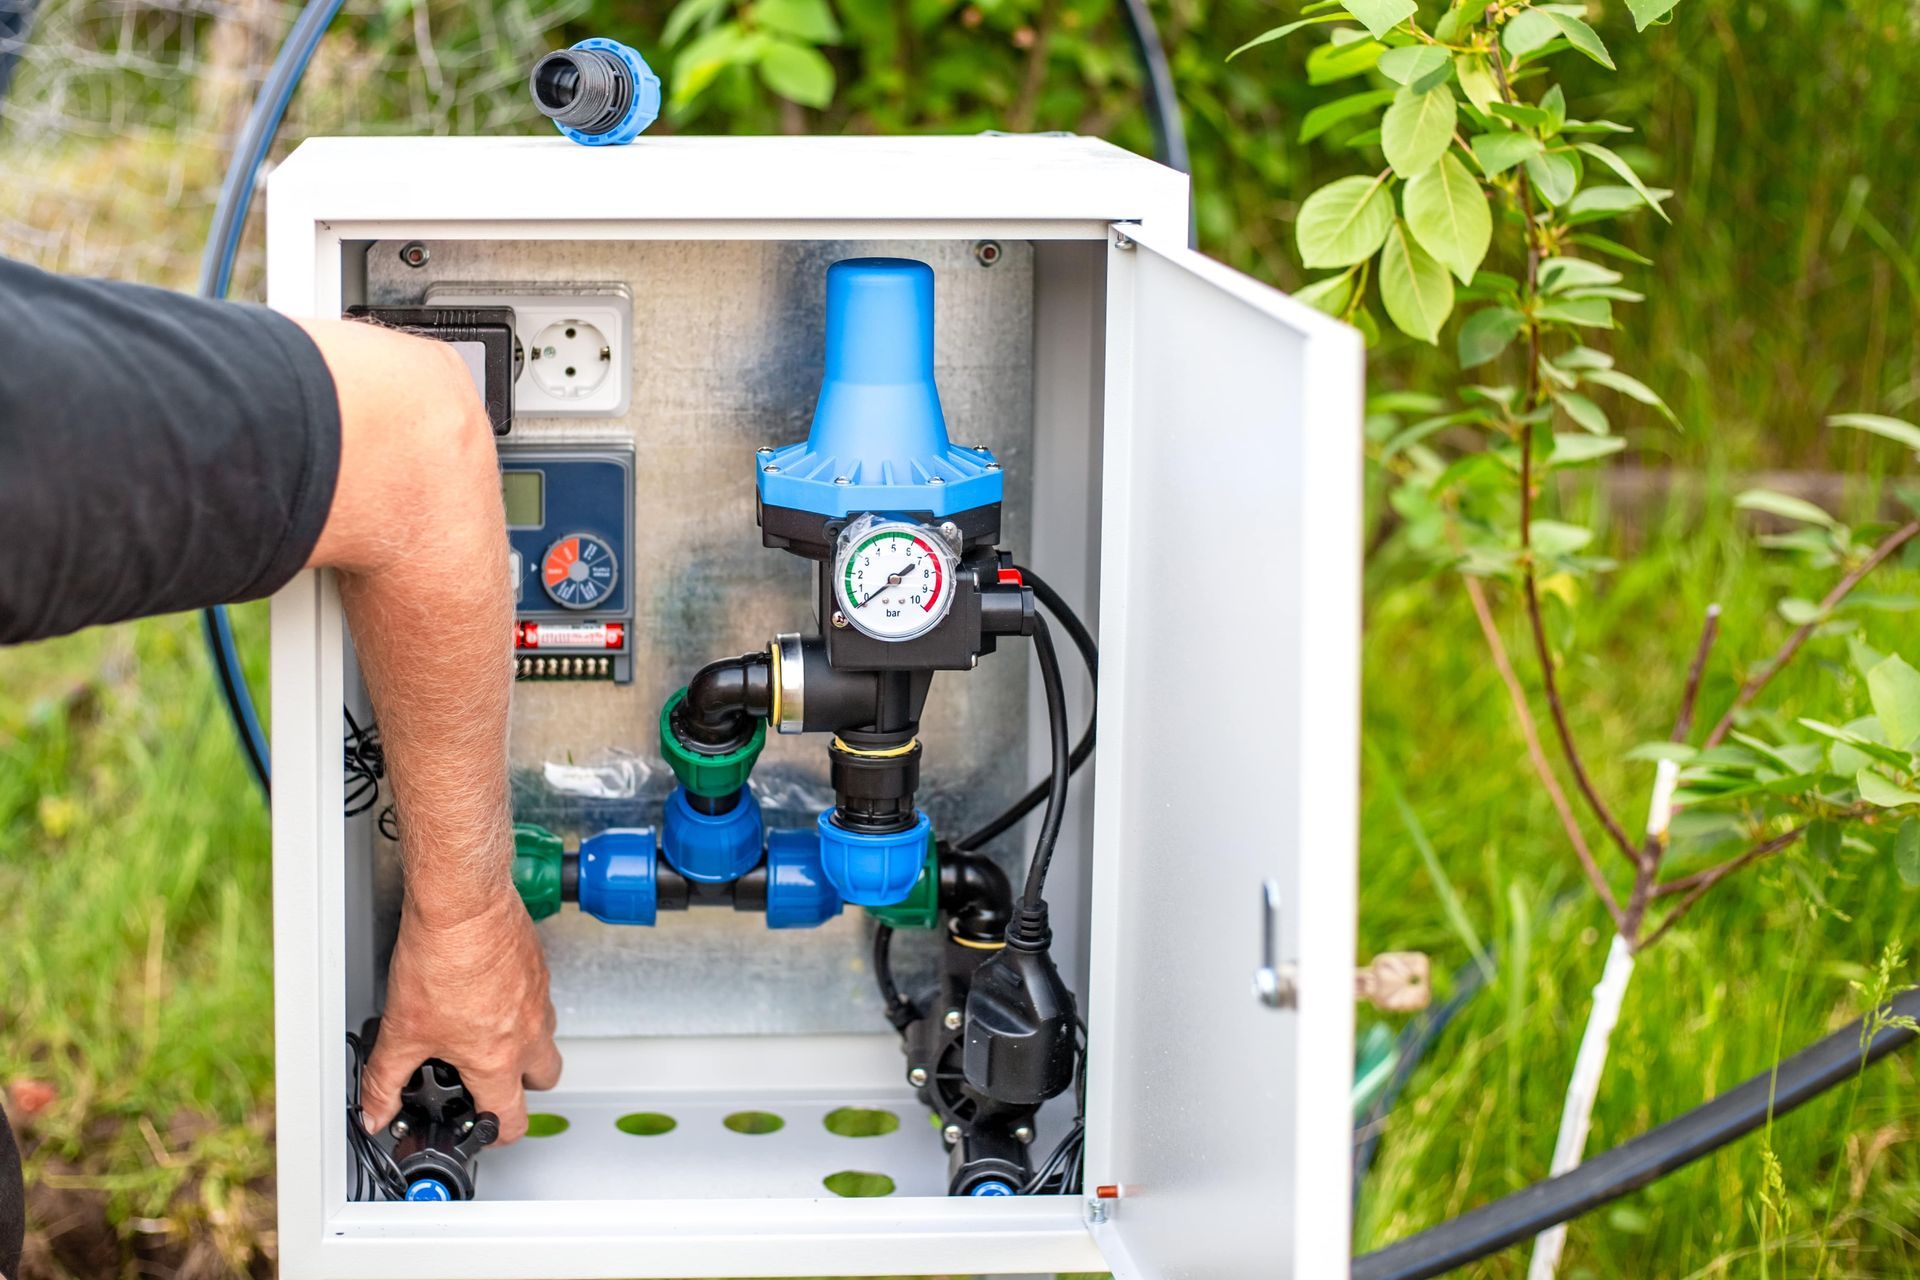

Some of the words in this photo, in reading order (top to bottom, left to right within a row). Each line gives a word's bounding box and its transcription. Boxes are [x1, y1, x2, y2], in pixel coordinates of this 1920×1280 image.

[891, 544, 896, 552] 5
[906, 548, 911, 556] 6
[864, 558, 870, 566] 3
[917, 557, 922, 565] 7
[857, 571, 863, 579] 2
[924, 569, 929, 578] 8
[859, 584, 863, 593] 1
[922, 584, 928, 593] 9
[863, 592, 869, 601] 0
[910, 595, 920, 603] 10
[886, 609, 901, 617] bar
